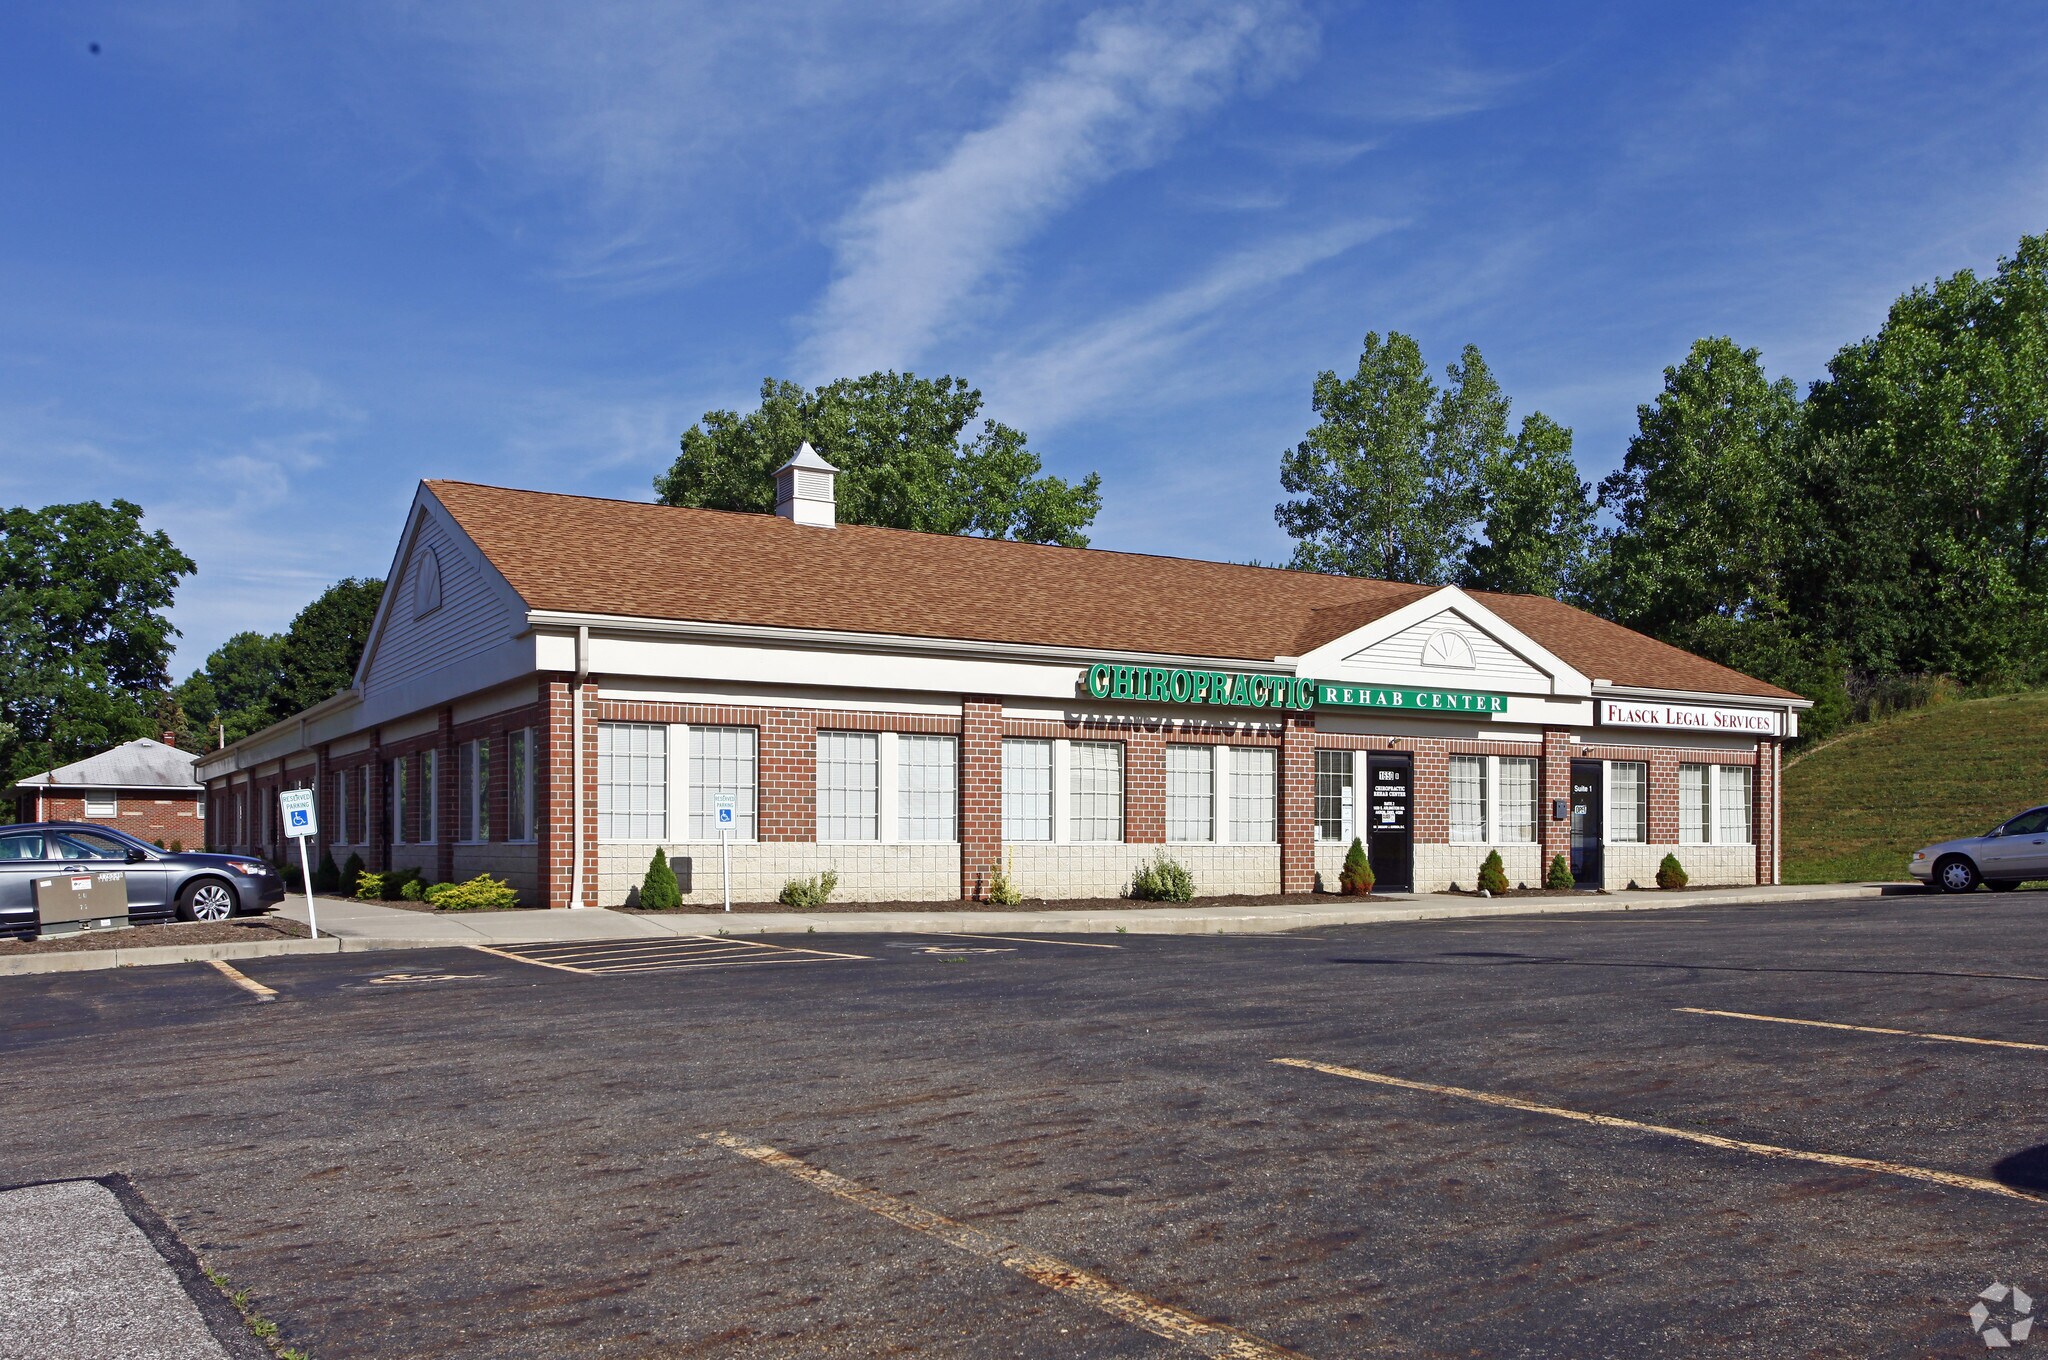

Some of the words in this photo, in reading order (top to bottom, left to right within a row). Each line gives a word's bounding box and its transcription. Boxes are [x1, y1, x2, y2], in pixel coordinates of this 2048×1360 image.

[1088, 664, 1314, 710] CHIROPRACTIC
[1325, 687, 1403, 706] REHAB
[1416, 693, 1502, 711] CENTER
[1608, 704, 1660, 724] FLASCK
[1666, 707, 1709, 727] LEGAL
[1713, 710, 1770, 730] SERVICES
[282, 794, 310, 802] RESERVED
